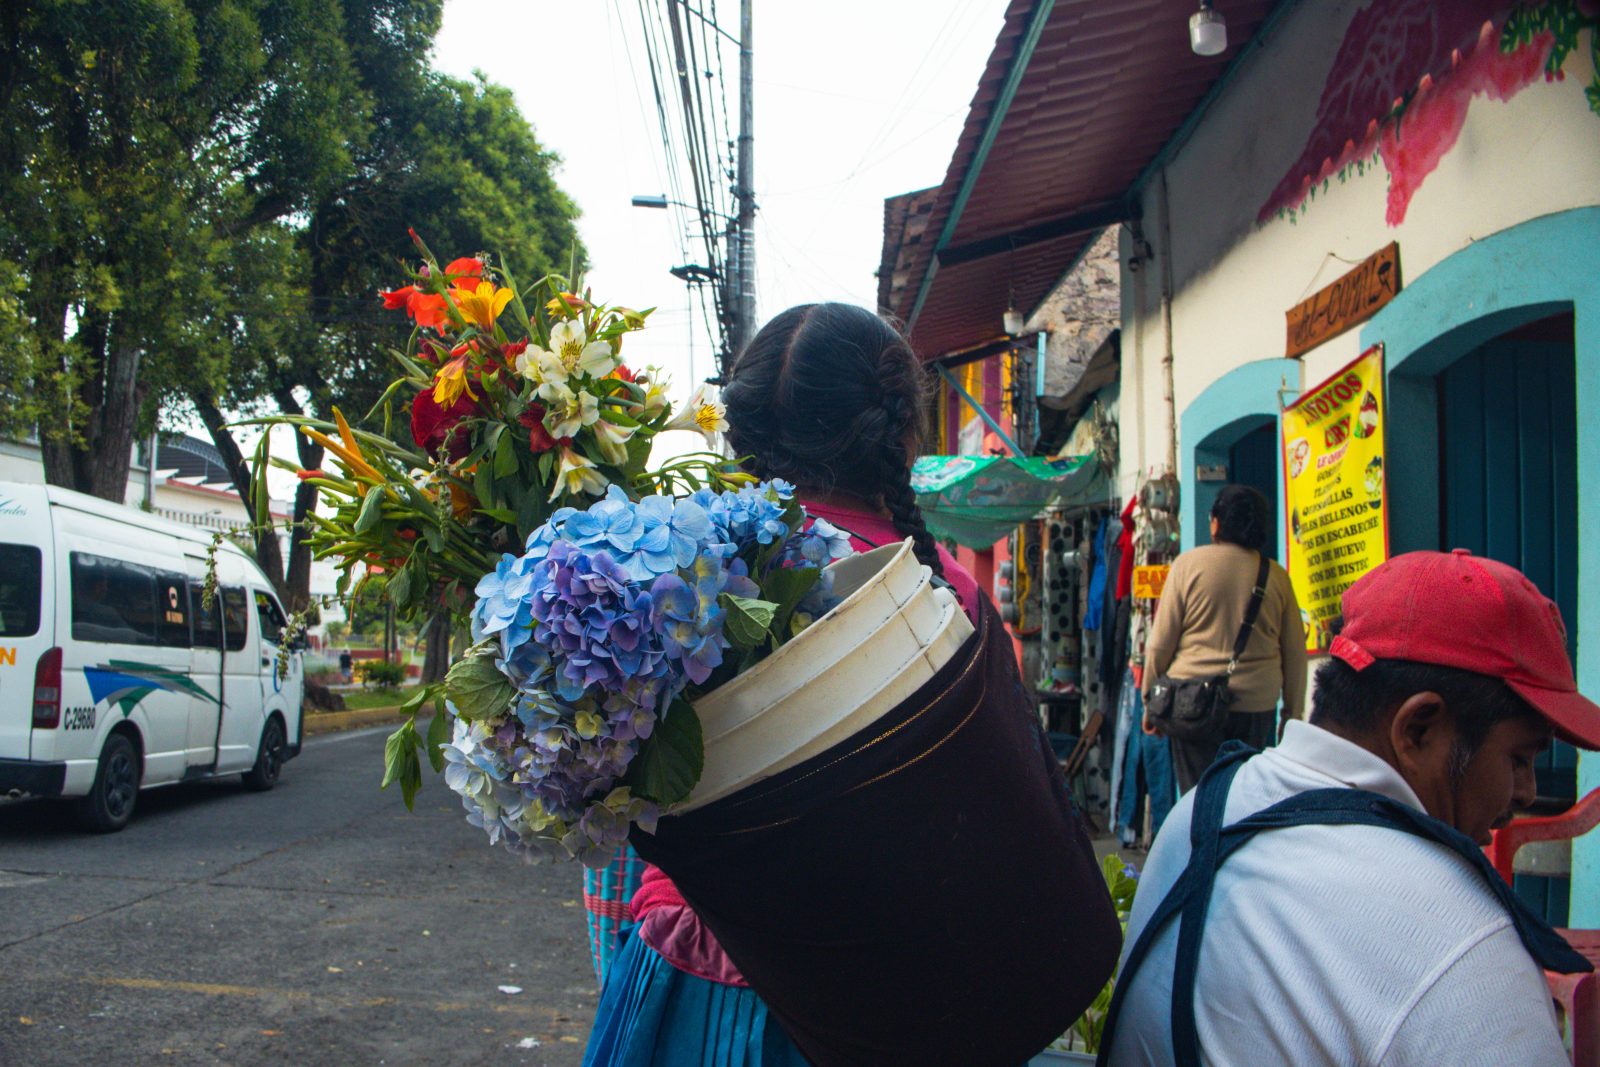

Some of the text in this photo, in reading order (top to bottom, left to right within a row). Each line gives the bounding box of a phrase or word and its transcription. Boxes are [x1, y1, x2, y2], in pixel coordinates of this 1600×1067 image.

[1326, 515, 1379, 543] ESCABECHE
[1321, 549, 1333, 563] DE
[1333, 540, 1367, 560] HUEVO
[1325, 566, 1337, 580] DE
[1337, 557, 1370, 577] BISTEC
[63, 707, 97, 731] C-29680
